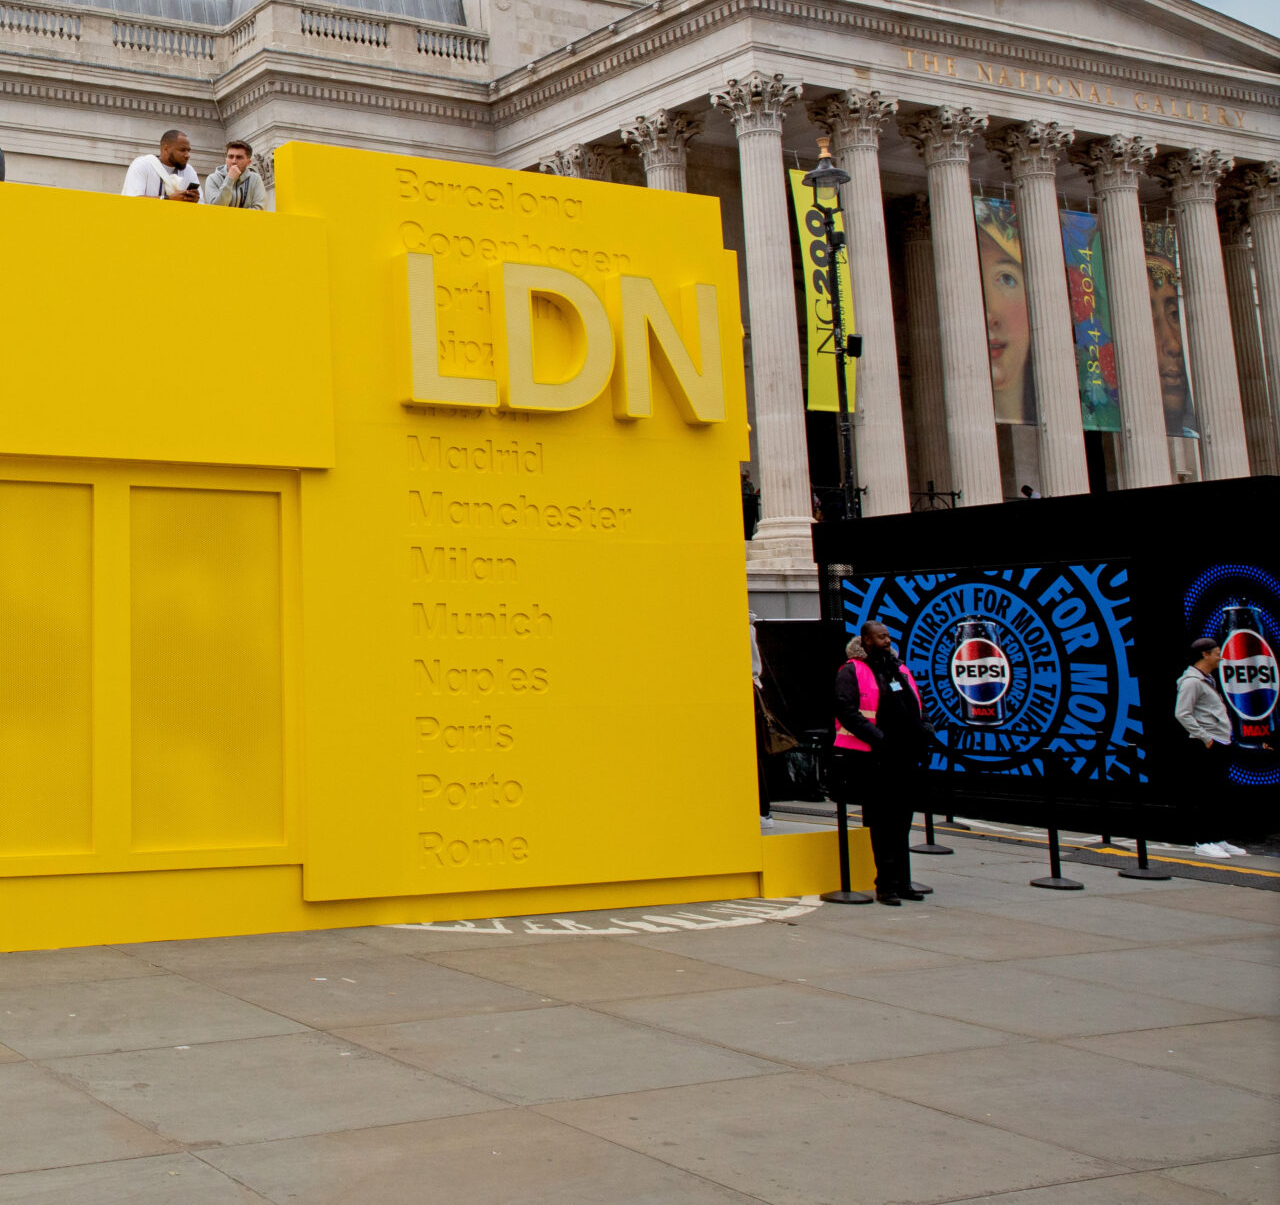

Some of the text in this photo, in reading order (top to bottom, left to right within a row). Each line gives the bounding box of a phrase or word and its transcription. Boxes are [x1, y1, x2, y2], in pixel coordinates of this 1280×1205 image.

[901, 48, 1246, 129] THE NATIONAL GALLERY
[395, 167, 584, 221] Barcelona
[805, 209, 835, 356] NG200
[404, 251, 726, 424] LDN
[406, 435, 545, 475] Madrid
[409, 490, 632, 532] Manchester
[410, 546, 518, 585] Milan
[412, 602, 554, 639] Munich
[909, 589, 967, 663] THIRSTY
[973, 587, 1012, 621] FOR
[1010, 606, 1057, 675] MORE
[1037, 574, 1100, 656] FOR
[413, 659, 550, 703] Naples
[934, 637, 961, 709] FOR MORE
[955, 664, 1006, 679] PEPSI
[1003, 636, 1028, 713] FOR MORE
[1223, 665, 1277, 684] PEPSI
[972, 707, 996, 717] MAX
[1242, 724, 1270, 737] MAX
[415, 715, 515, 753] Paris
[417, 773, 524, 811] Porto
[418, 831, 530, 869] Rome
